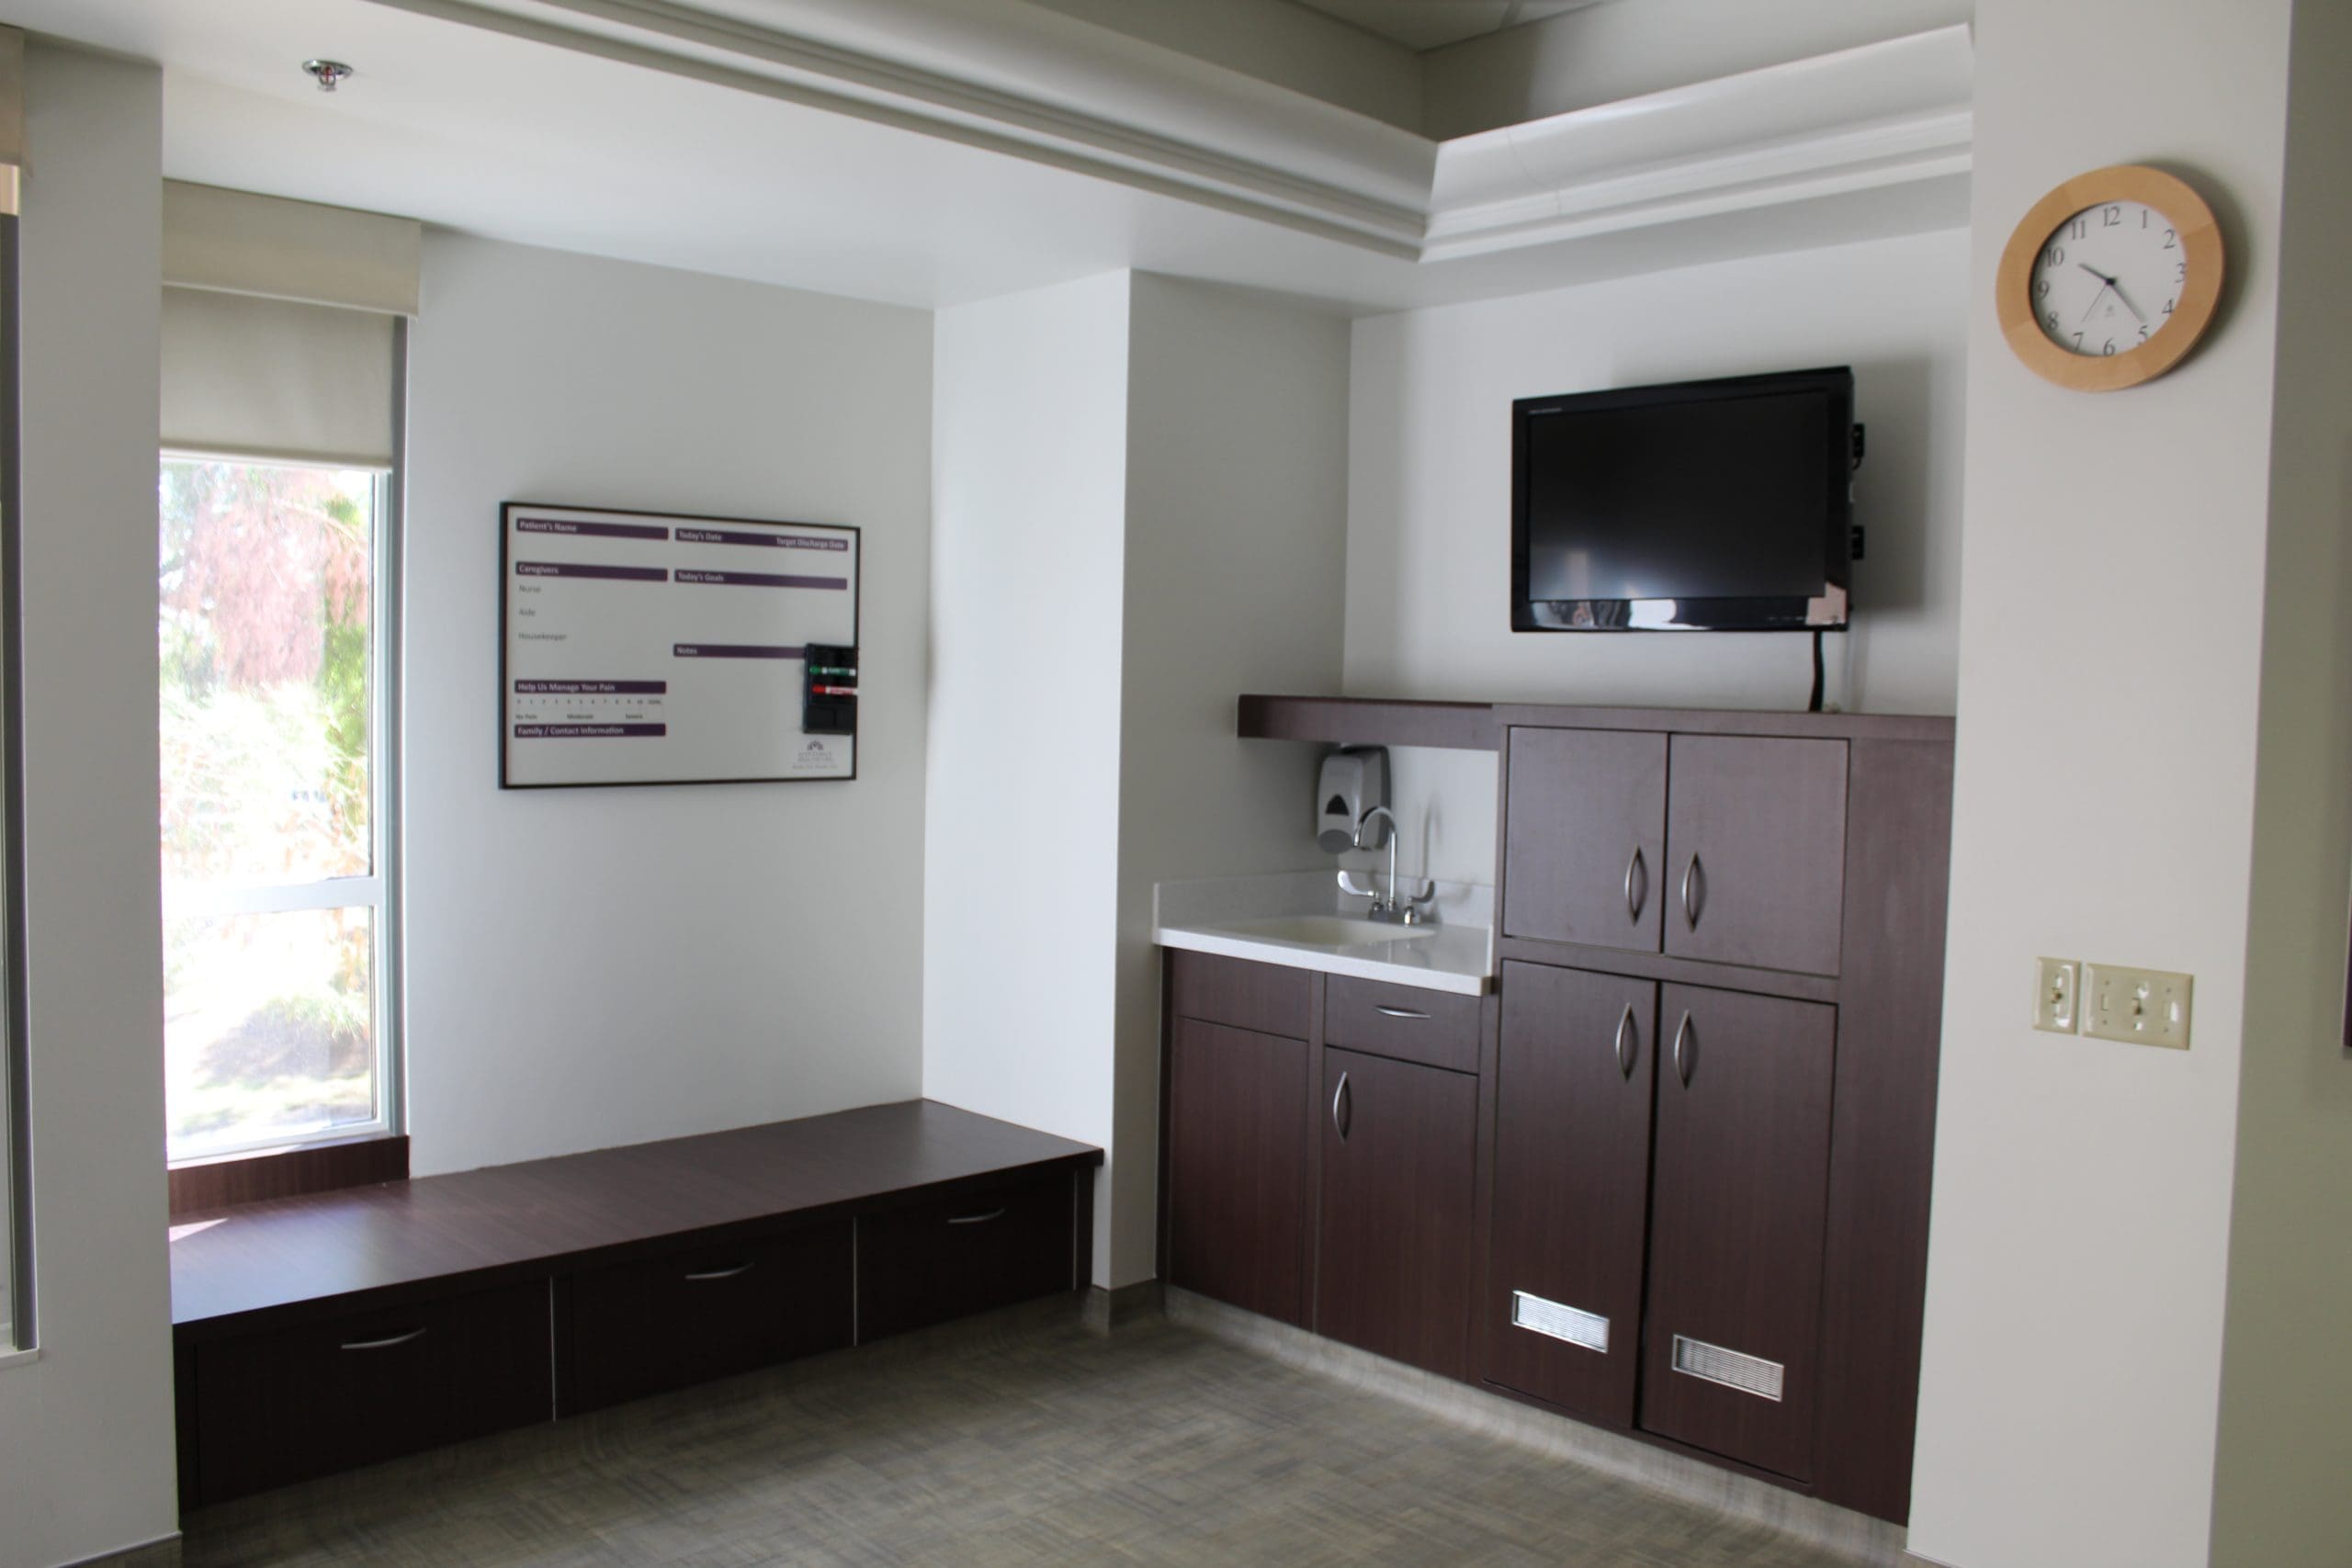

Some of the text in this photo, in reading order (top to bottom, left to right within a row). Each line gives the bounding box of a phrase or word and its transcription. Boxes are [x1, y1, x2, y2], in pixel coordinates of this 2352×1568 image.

[2102, 206, 2120, 227] 12
[2141, 209, 2148, 229] 1
[2070, 220, 2086, 240] 11
[2163, 229, 2177, 249] 2
[2045, 247, 2064, 266] 10
[2175, 263, 2187, 283] 3
[2037, 280, 2049, 299] 9
[2162, 299, 2175, 316] 4
[2047, 310, 2059, 331] 8
[2072, 332, 2085, 352] 7
[2137, 325, 2149, 345] 5
[2102, 337, 2116, 356] 6
[519, 521, 577, 532] Patient's Name
[679, 531, 722, 541] Today's Date
[775, 537, 844, 549] Target Discharge Date
[518, 564, 559, 575] Caregivers
[678, 571, 724, 582] Today's Goals
[519, 584, 541, 593] Nurse
[519, 608, 536, 616] Aide
[518, 633, 567, 641] Housekeeper
[676, 647, 697, 655] Notes
[518, 682, 536, 692] Help
[537, 682, 548, 691] Us
[549, 682, 579, 693] Manage
[599, 683, 616, 692] Pain
[518, 726, 542, 737] Family
[549, 726, 579, 735] Contact
[581, 725, 624, 735] Information
